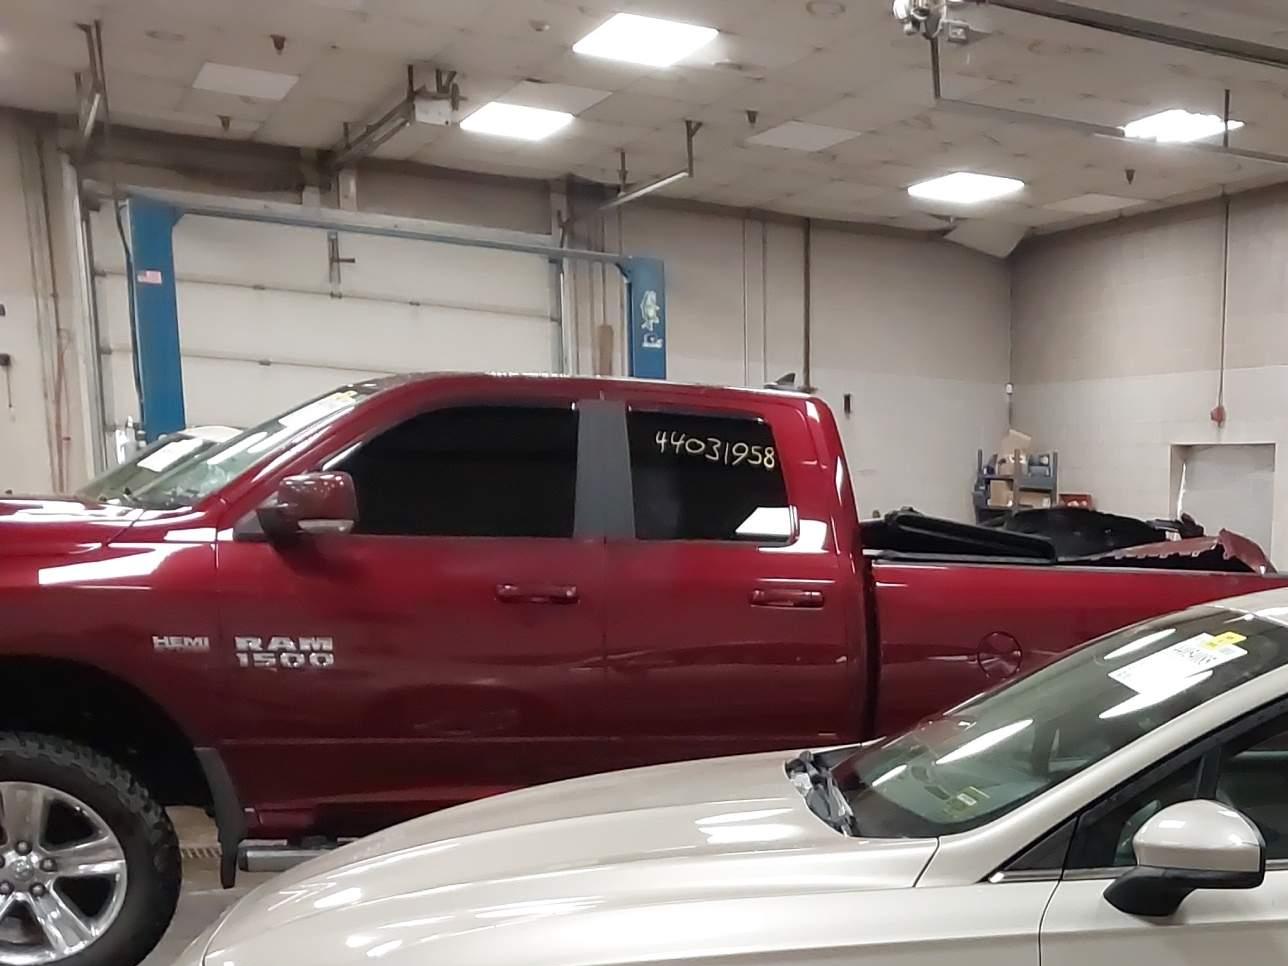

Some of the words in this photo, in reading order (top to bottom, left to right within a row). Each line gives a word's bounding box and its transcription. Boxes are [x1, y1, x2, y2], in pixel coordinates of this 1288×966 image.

[655, 431, 775, 469] 44031958
[152, 636, 210, 649] HEMI
[235, 636, 333, 650] RAM
[236, 652, 335, 667] 1500
